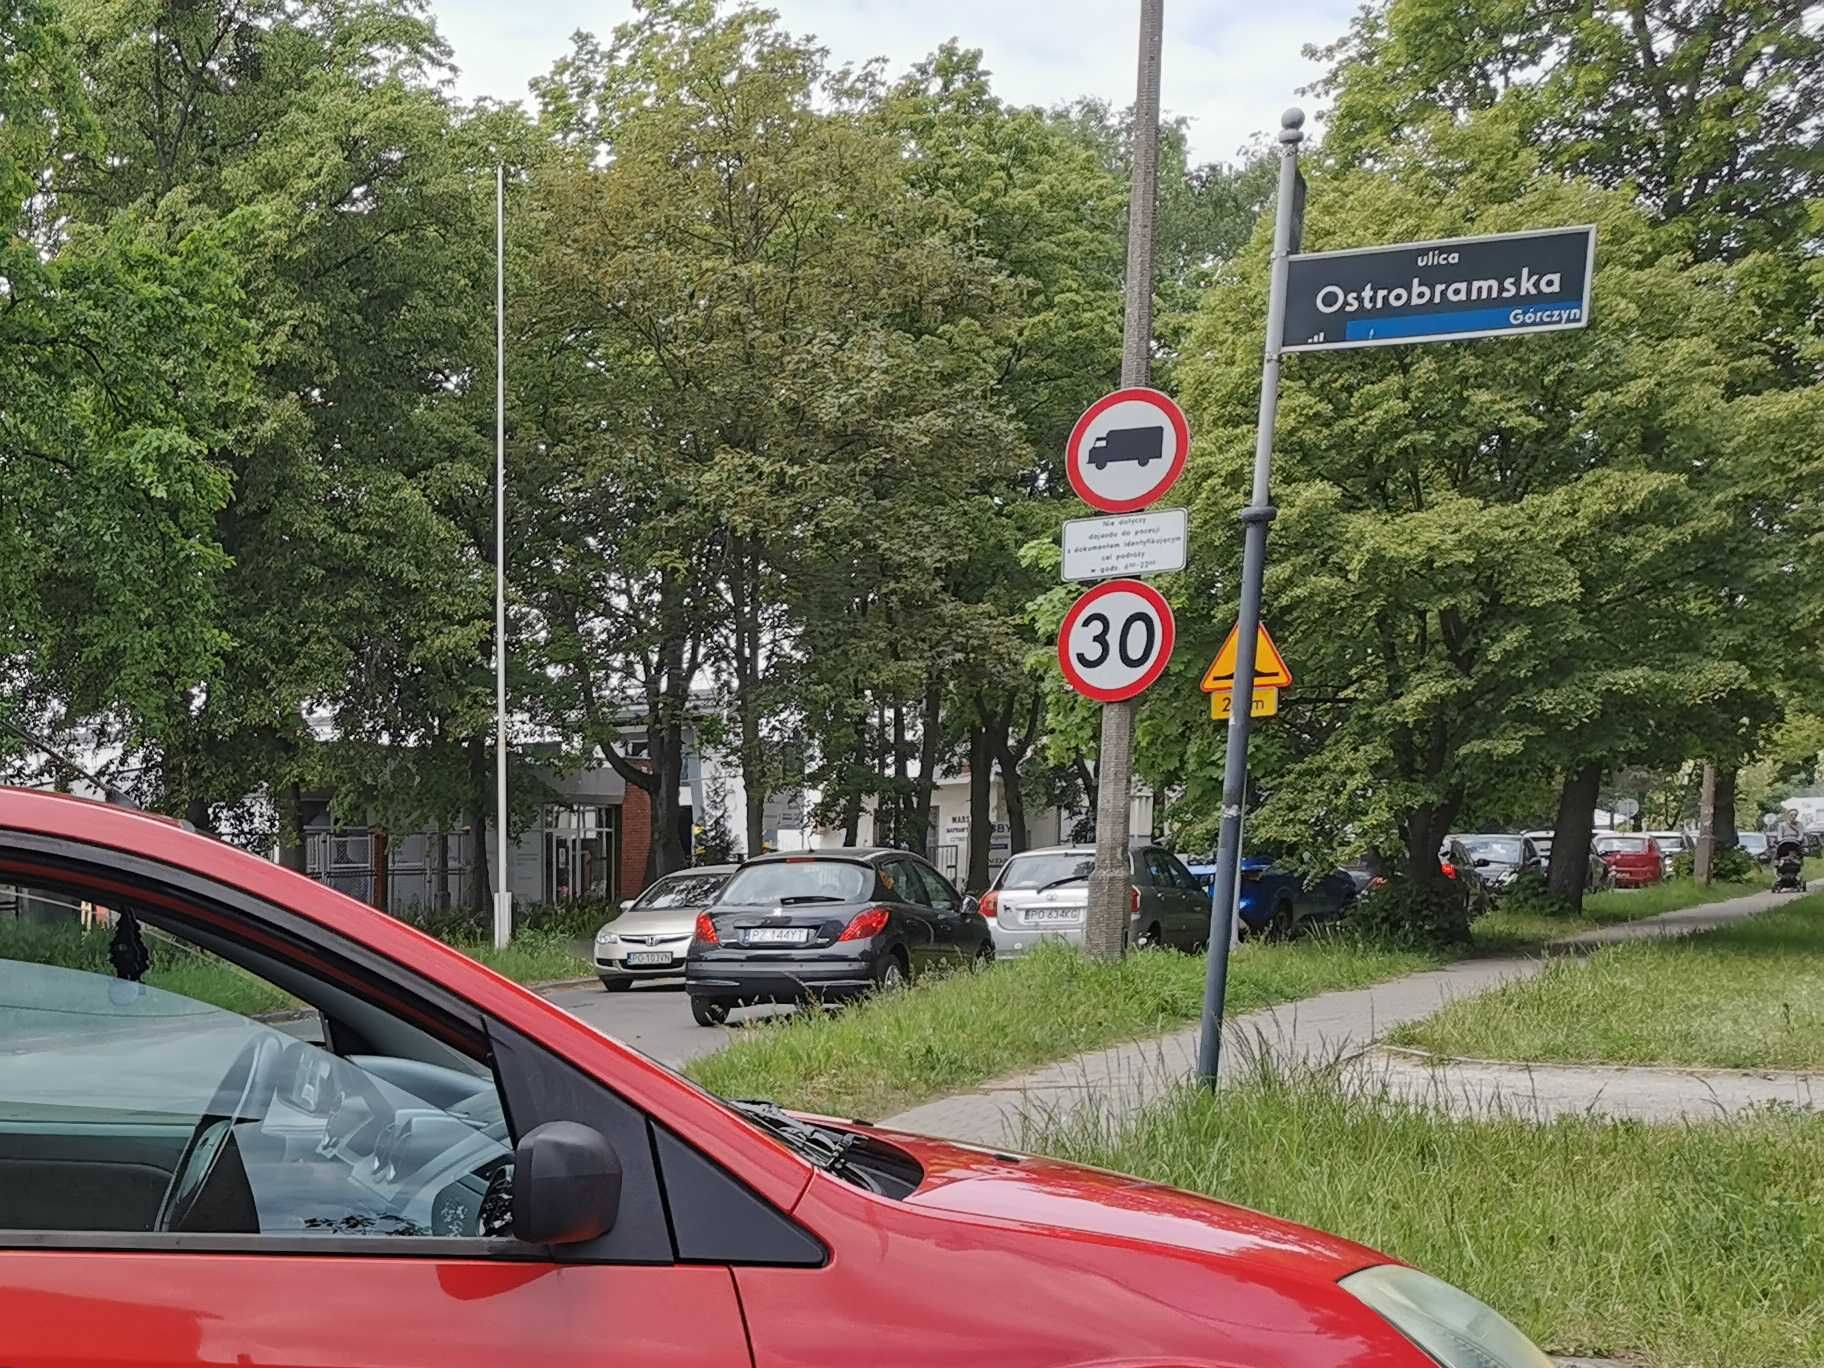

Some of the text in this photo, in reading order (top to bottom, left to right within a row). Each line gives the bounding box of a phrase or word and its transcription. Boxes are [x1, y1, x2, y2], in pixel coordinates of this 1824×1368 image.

[1417, 251, 1459, 267] ulica
[1316, 267, 1561, 313] Ostrobramska
[1509, 306, 1581, 325] Górczyn
[1076, 611, 1155, 669] 30
